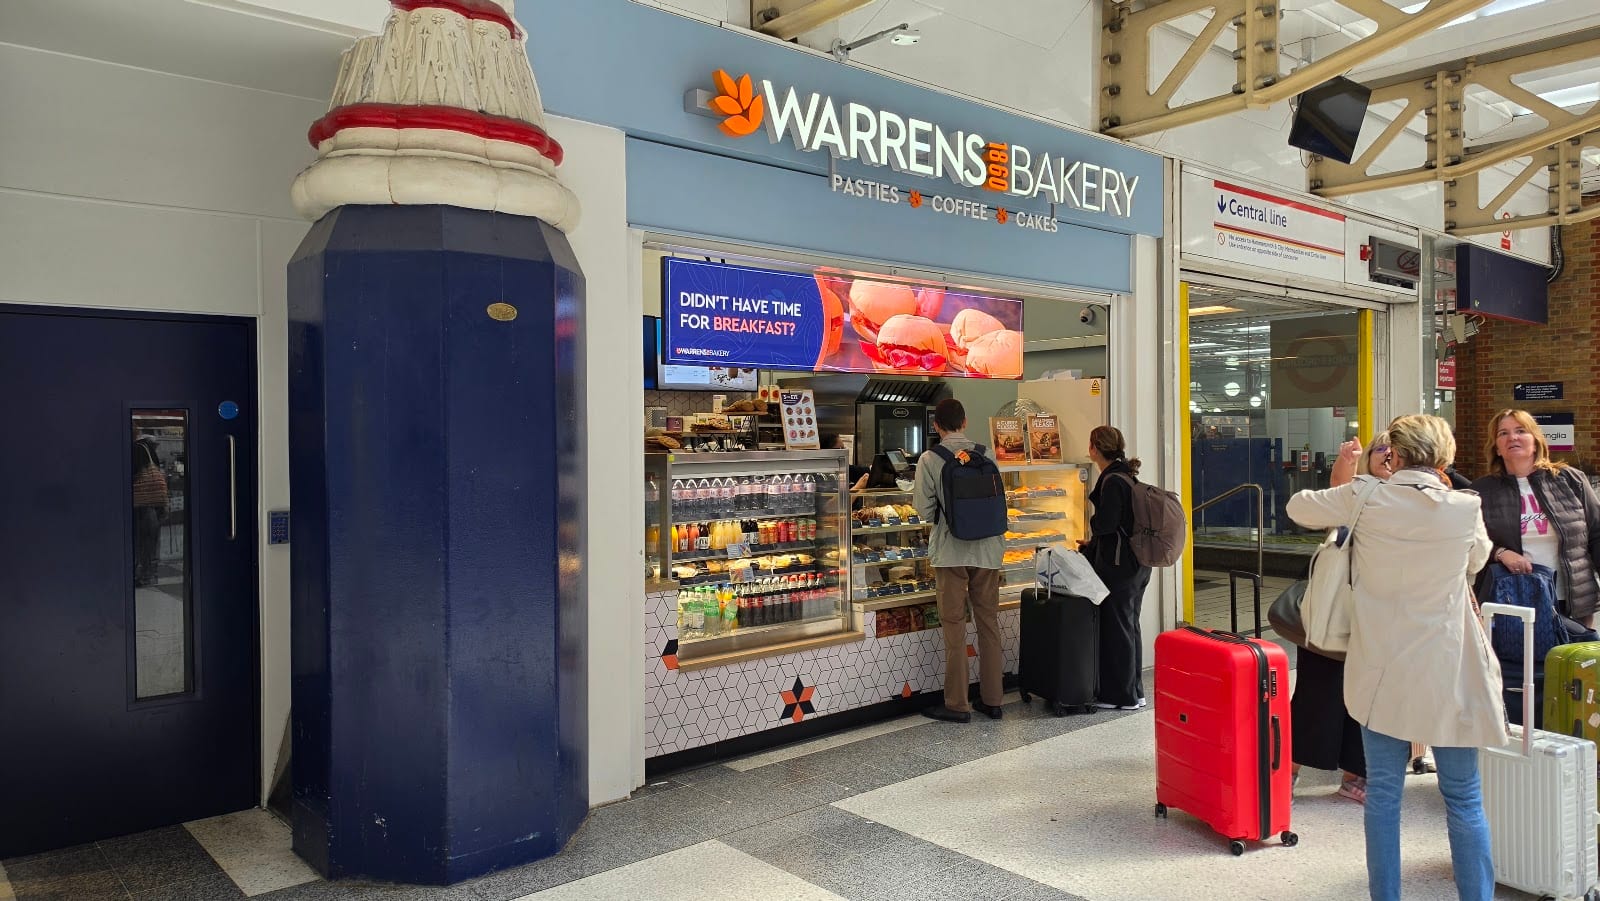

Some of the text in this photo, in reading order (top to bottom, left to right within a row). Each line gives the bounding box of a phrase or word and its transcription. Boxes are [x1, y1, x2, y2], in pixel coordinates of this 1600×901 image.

[760, 79, 1140, 218] WARRENS 1860 BAKERY
[831, 174, 1058, 233] PASTIES COFFEE CAKES
[1229, 198, 1287, 228] Central line
[680, 291, 802, 317] DIDN'T HAVE TIME
[680, 314, 796, 337] FOR BREAKFAST?
